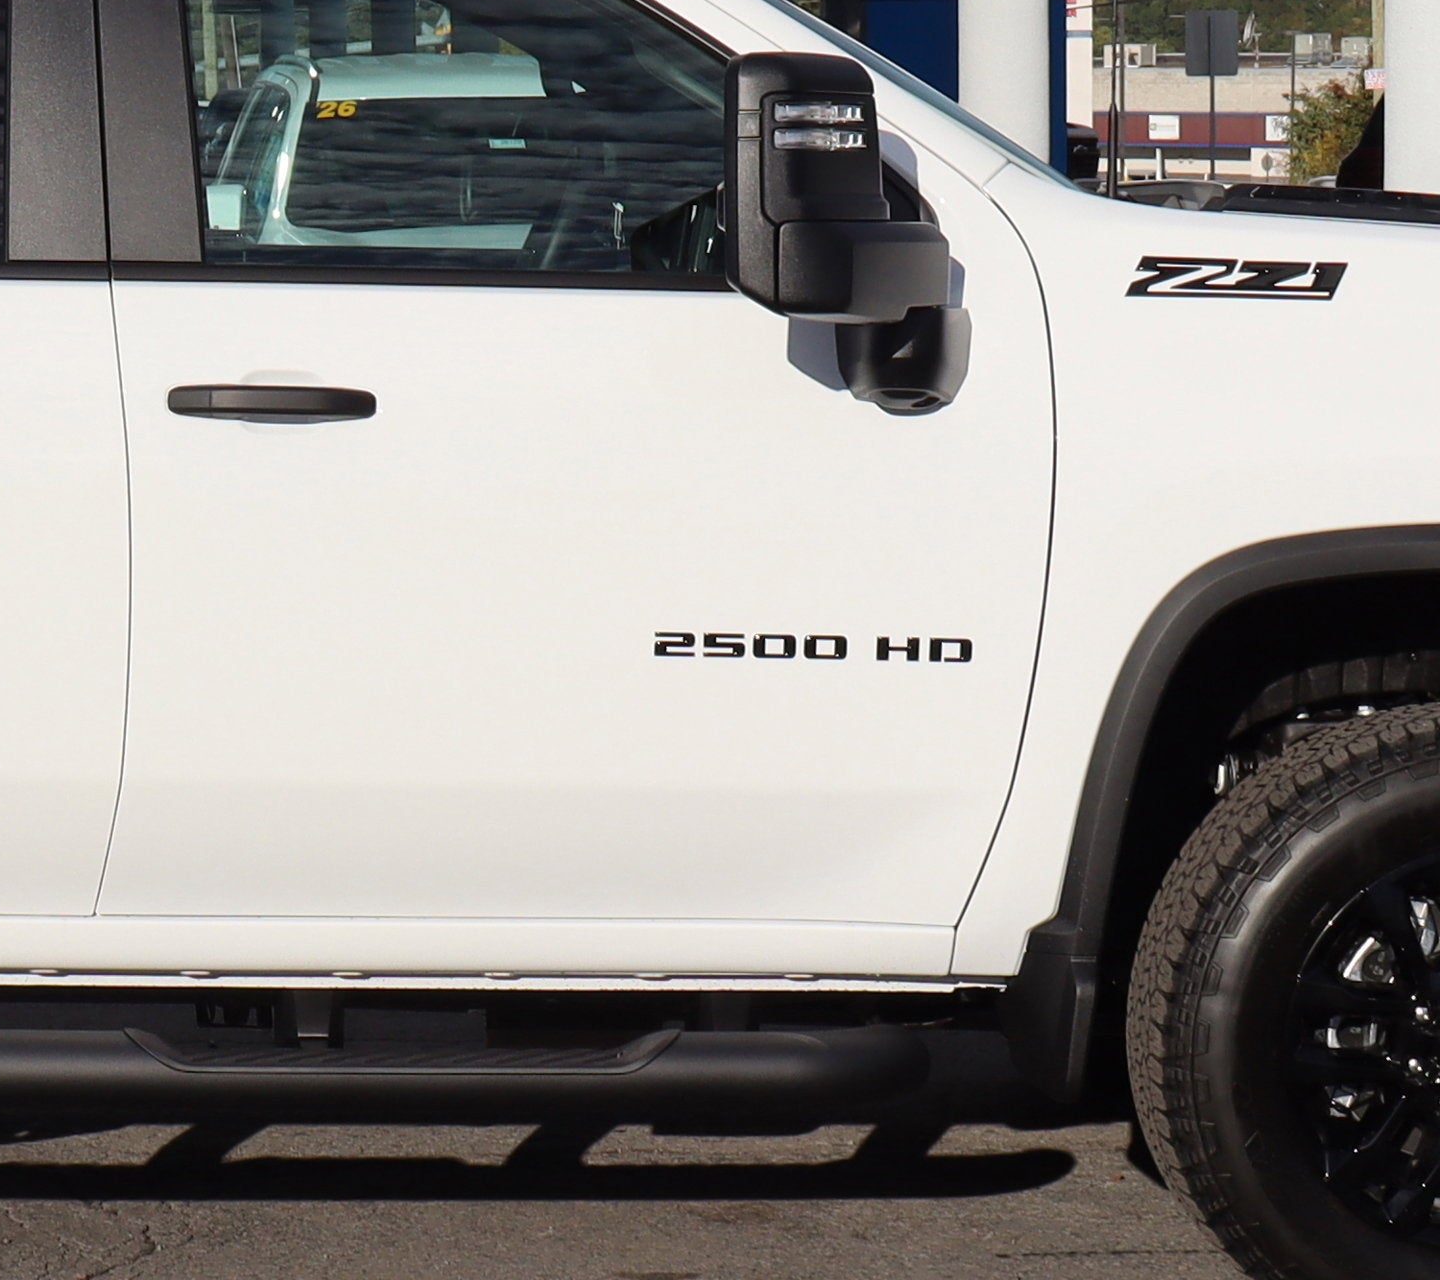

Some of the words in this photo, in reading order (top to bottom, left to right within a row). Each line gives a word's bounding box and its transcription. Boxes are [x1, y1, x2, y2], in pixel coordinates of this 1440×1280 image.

[1124, 255, 1349, 301] Z71
[653, 631, 849, 660] 2500
[875, 635, 974, 663] HD
